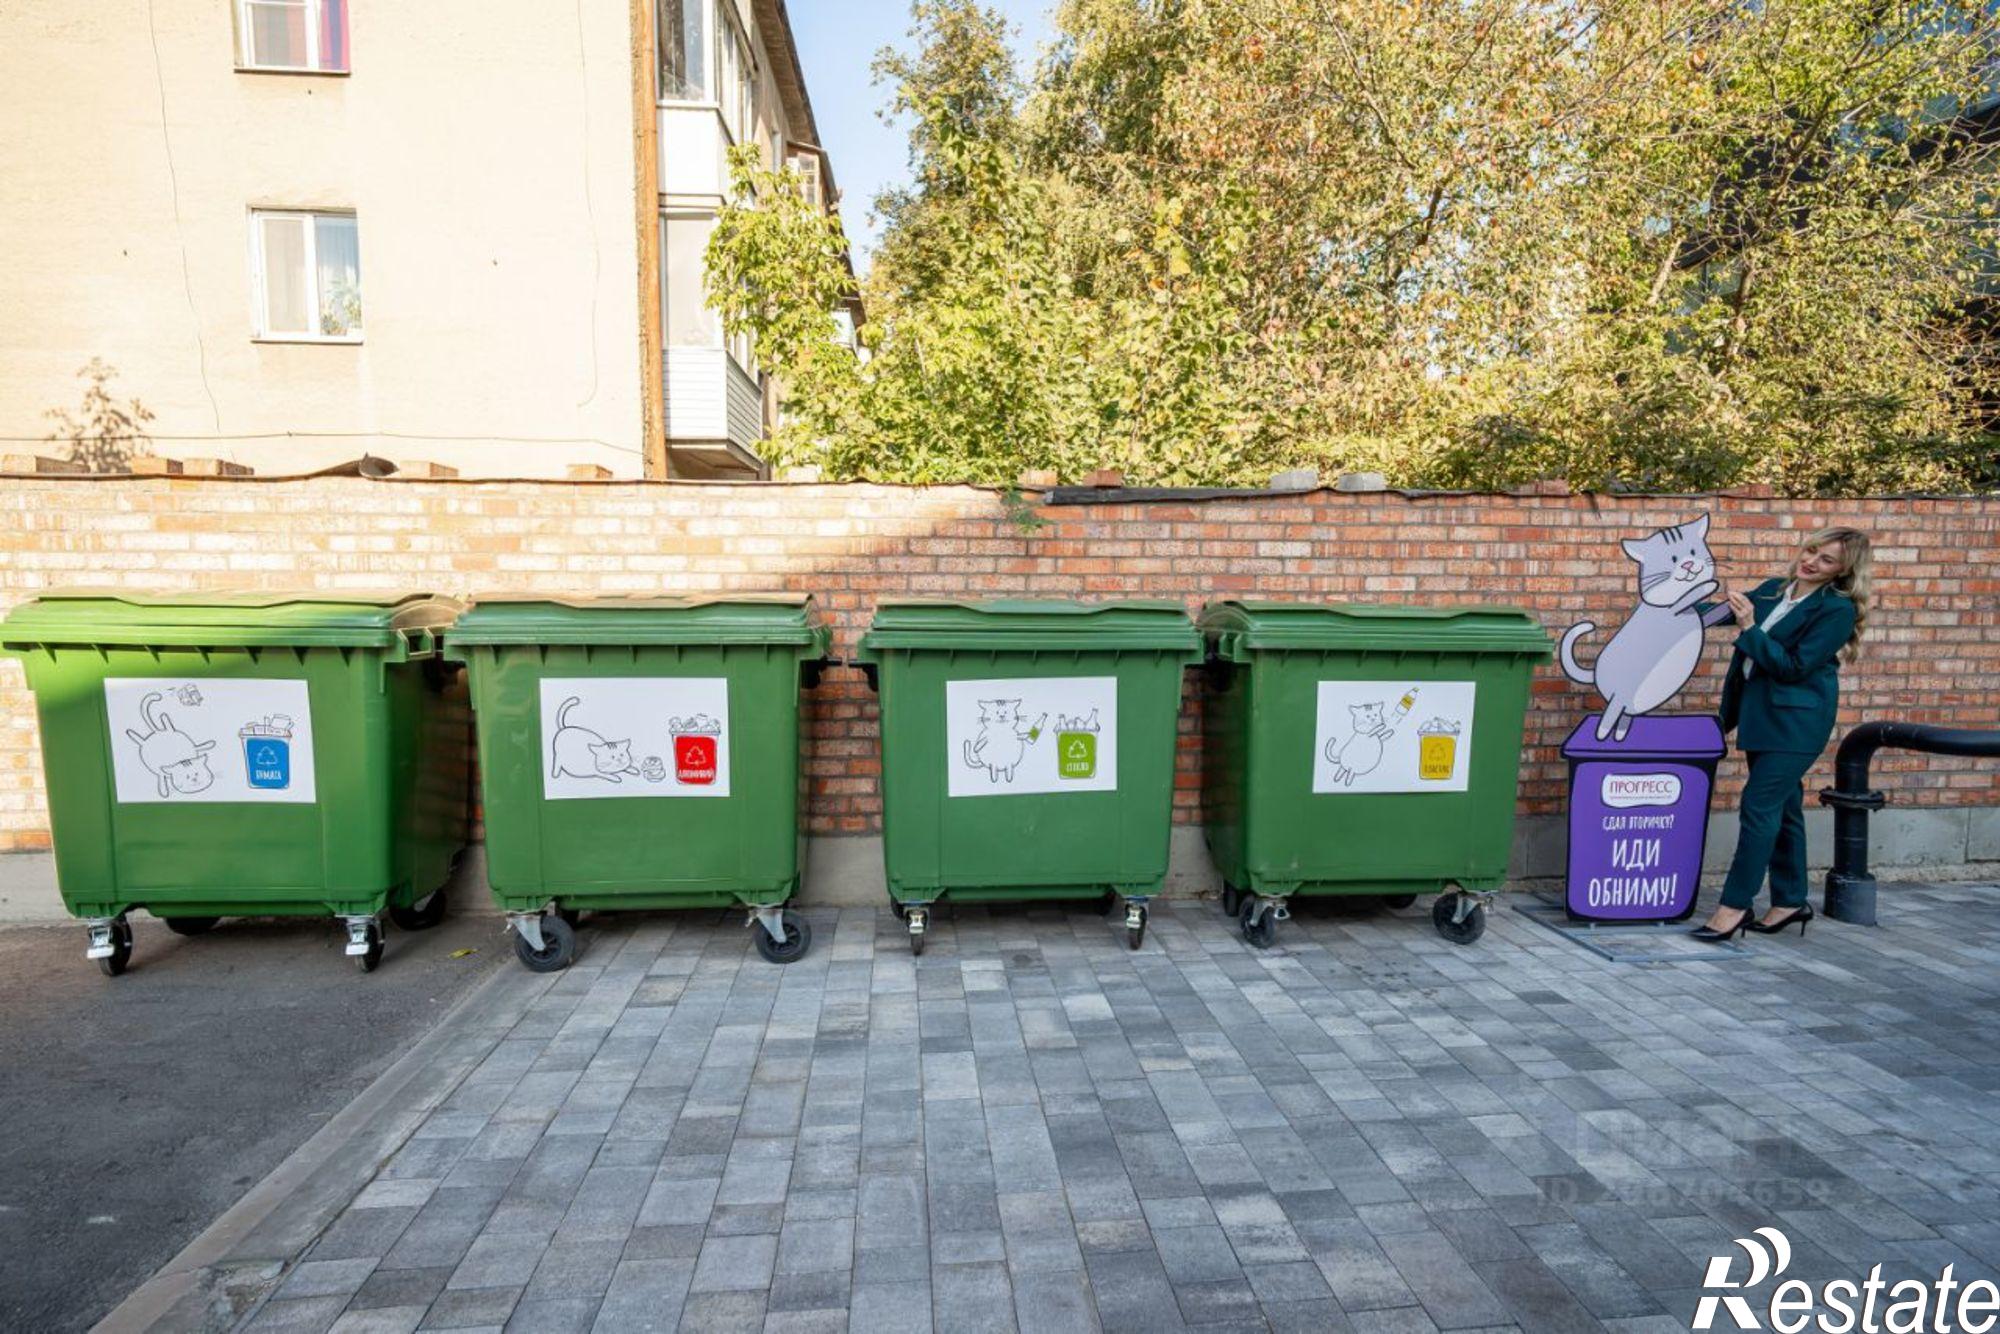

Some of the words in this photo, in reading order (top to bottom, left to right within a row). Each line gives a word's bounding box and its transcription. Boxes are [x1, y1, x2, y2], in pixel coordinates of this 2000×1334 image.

[1609, 780, 1673, 794] ПРОГРЕСС
[1612, 838, 1661, 871] ИДИ
[1588, 873, 1678, 907] ОБНИМУ!
